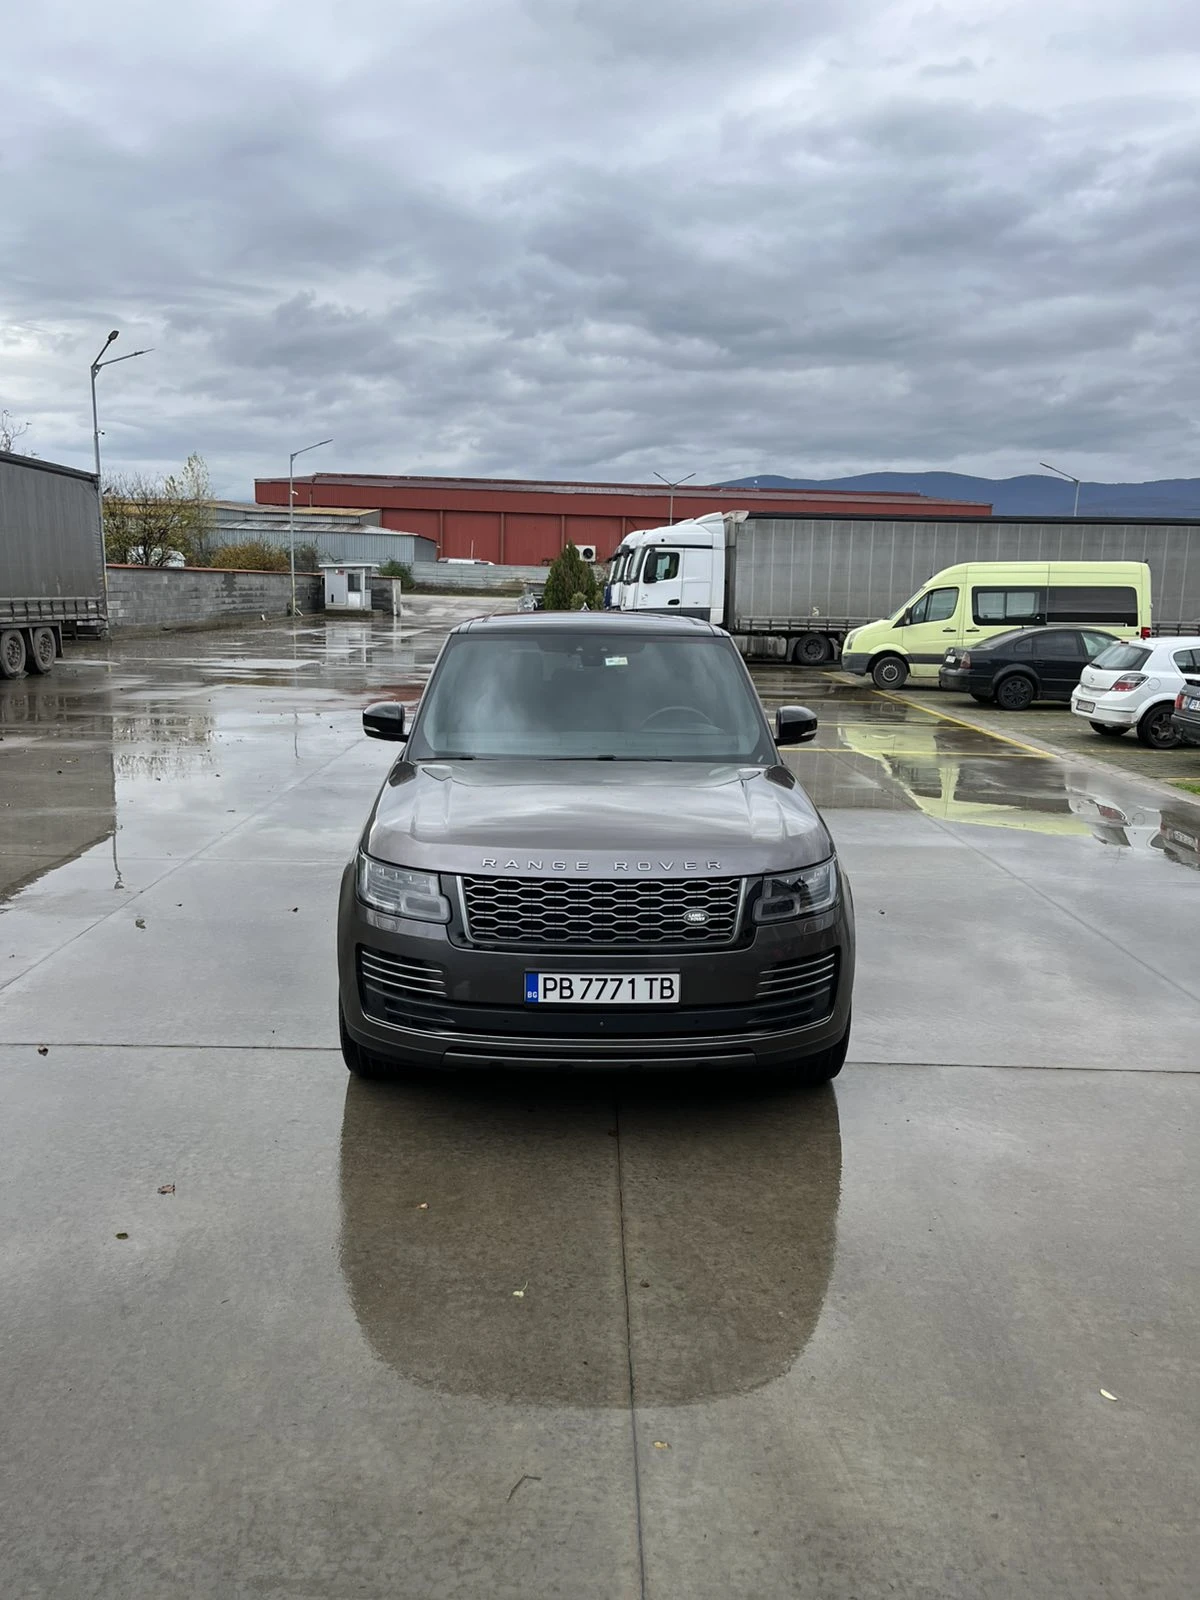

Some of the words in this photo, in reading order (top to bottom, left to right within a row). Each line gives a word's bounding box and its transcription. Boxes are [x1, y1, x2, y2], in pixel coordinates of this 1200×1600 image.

[482, 858, 589, 871] RANGE
[614, 861, 721, 871] ROVER
[542, 977, 574, 999] PB
[579, 977, 635, 1000] 7771
[644, 977, 675, 1000] TB
